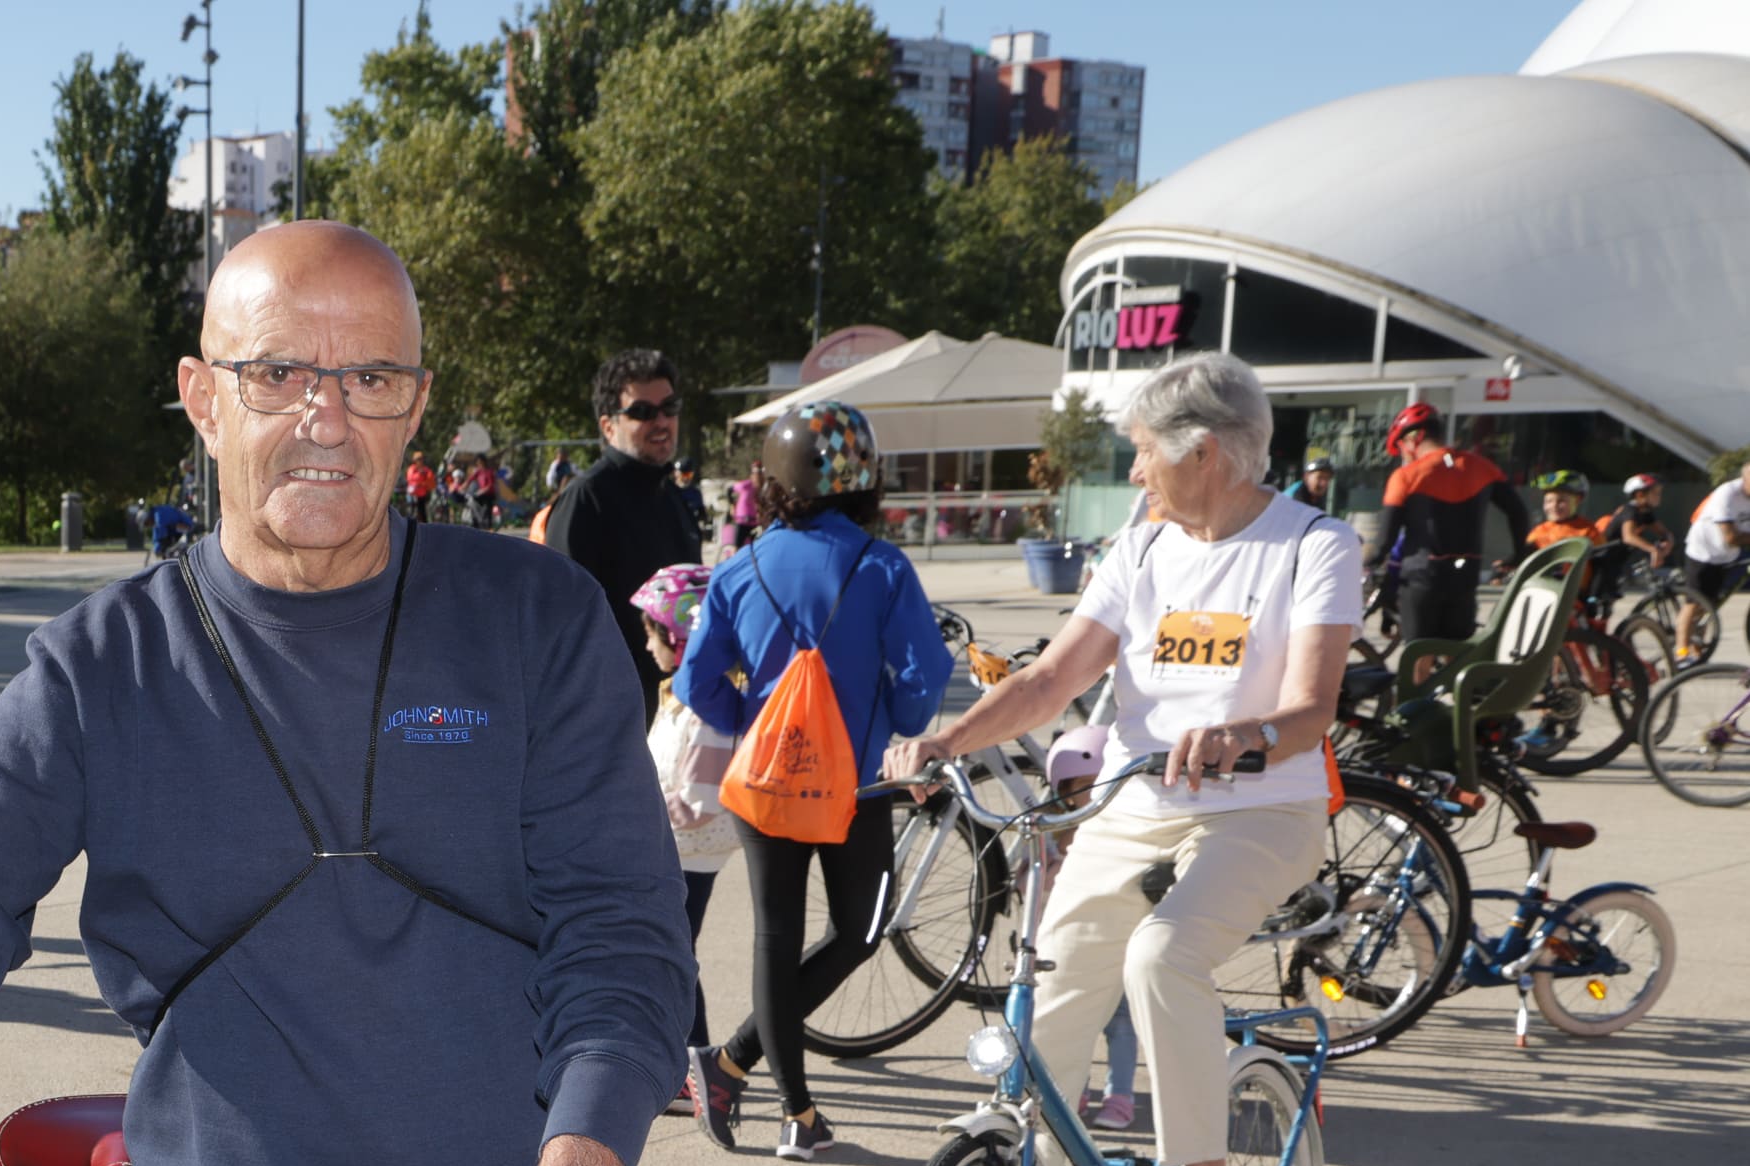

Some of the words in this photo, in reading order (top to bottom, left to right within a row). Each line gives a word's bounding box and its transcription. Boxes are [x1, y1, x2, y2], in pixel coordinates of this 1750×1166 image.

[1157, 637, 1242, 666] 2013
[403, 730, 435, 741] Since
[439, 730, 469, 741] 1970
